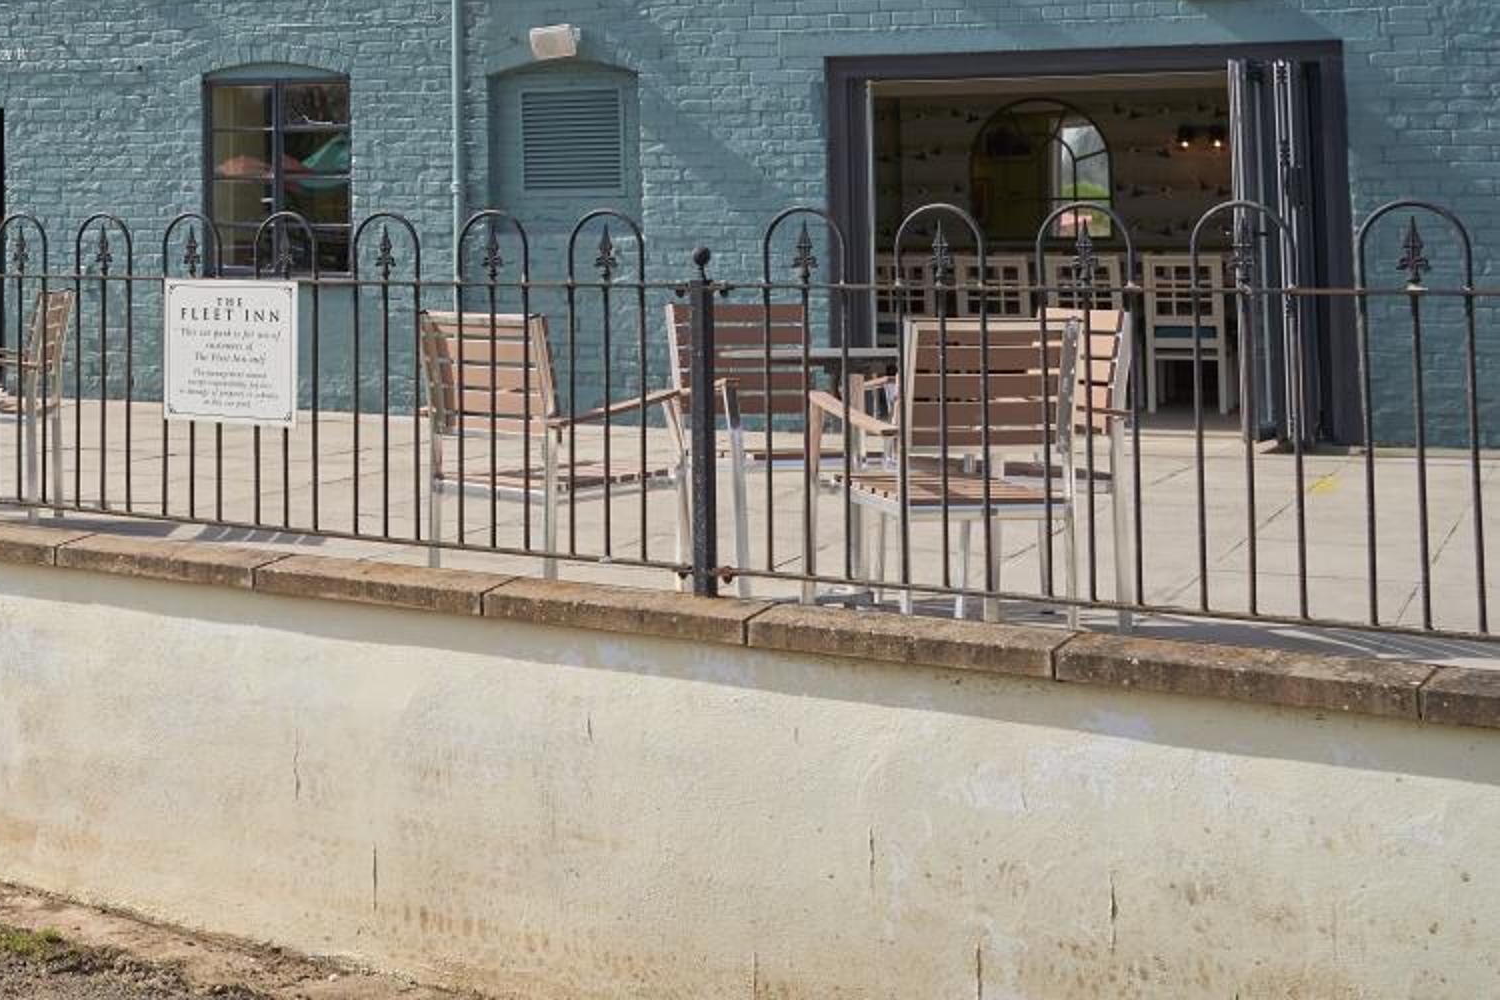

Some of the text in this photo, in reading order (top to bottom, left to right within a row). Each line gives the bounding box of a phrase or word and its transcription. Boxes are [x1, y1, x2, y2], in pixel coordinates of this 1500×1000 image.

[217, 297, 243, 307] THE
[180, 307, 281, 323] FLEET INN
